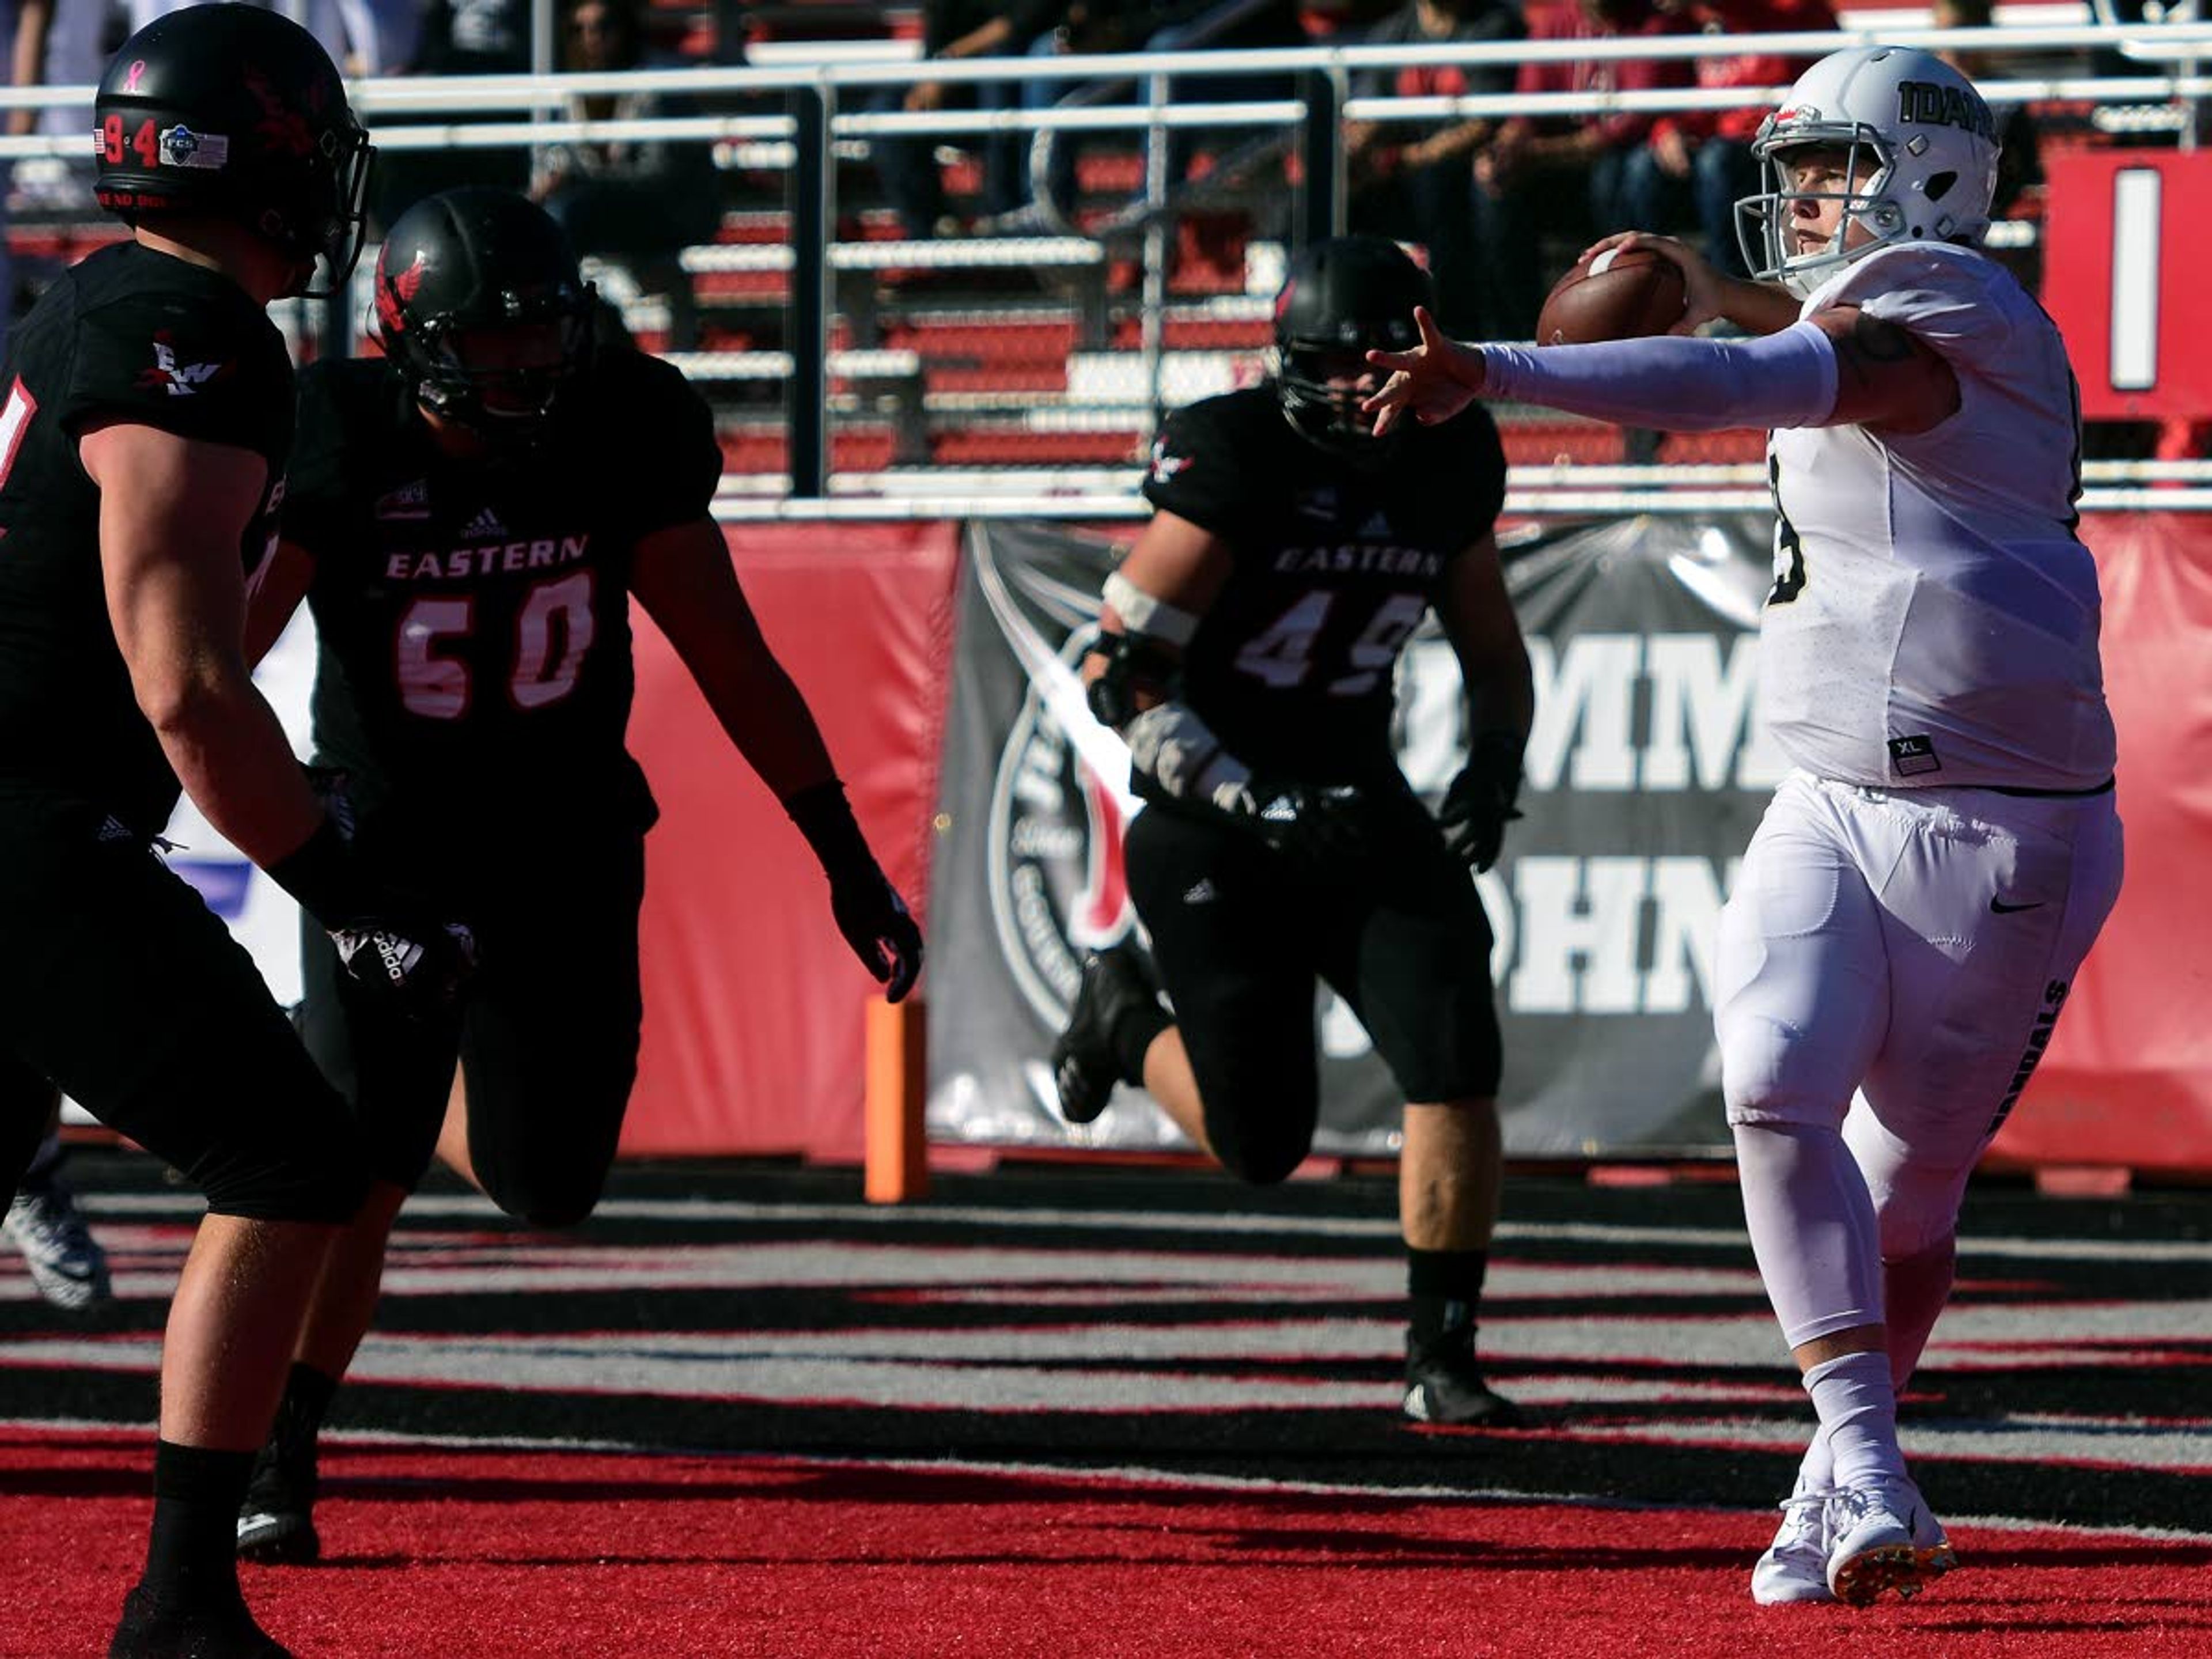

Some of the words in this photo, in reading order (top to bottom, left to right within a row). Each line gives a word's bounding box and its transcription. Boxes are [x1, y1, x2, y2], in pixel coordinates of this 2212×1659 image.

[104, 113, 158, 167] 94
[385, 533, 589, 579] EASTERN
[1272, 543, 1447, 578] EASTERN
[1234, 588, 1430, 696] 49
[1393, 632, 1794, 791] IMM
[1896, 741, 1922, 754] XL
[372, 930, 407, 987] adidas
